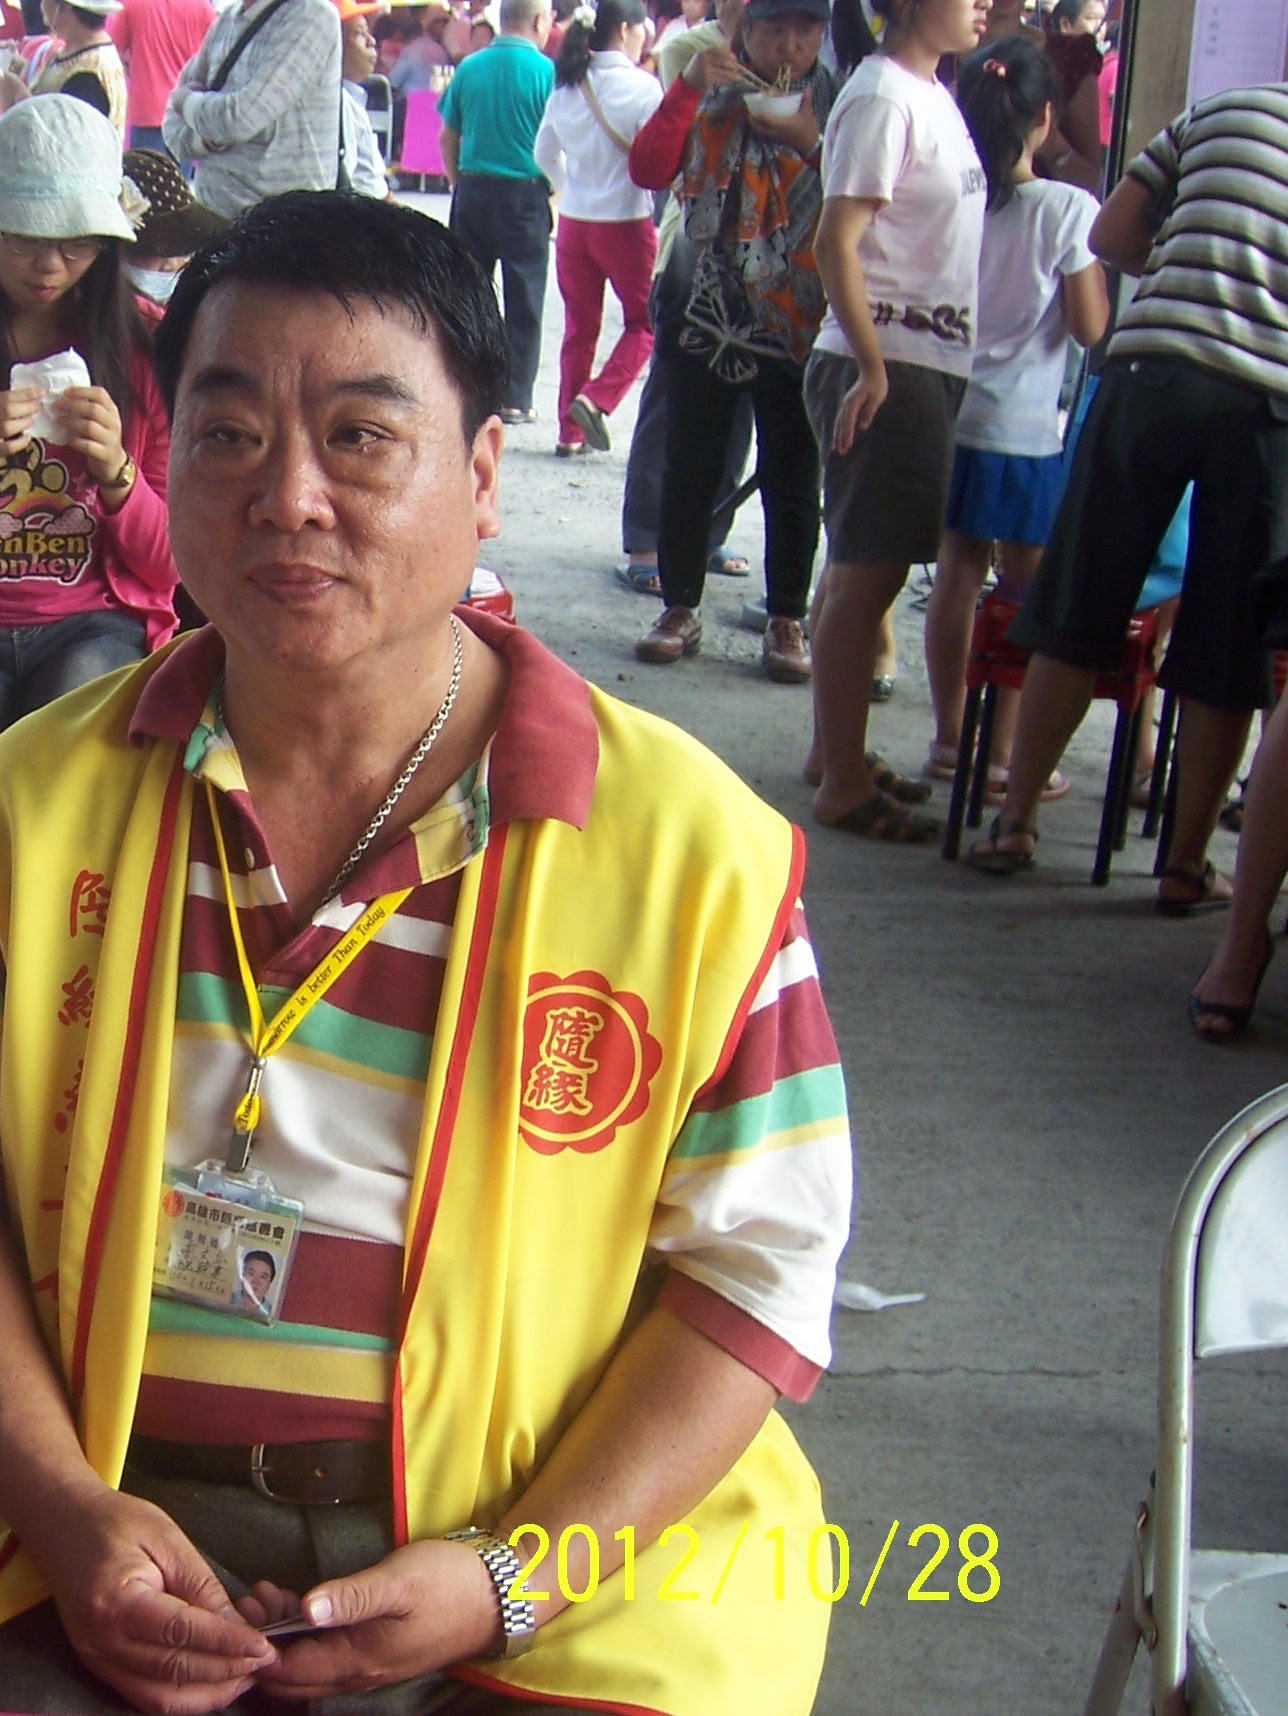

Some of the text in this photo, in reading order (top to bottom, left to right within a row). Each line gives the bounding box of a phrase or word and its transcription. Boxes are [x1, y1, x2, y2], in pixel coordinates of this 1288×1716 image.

[296, 996, 308, 1007] is
[306, 965, 333, 994] better
[332, 938, 359, 964] Than
[356, 906, 386, 936] Today
